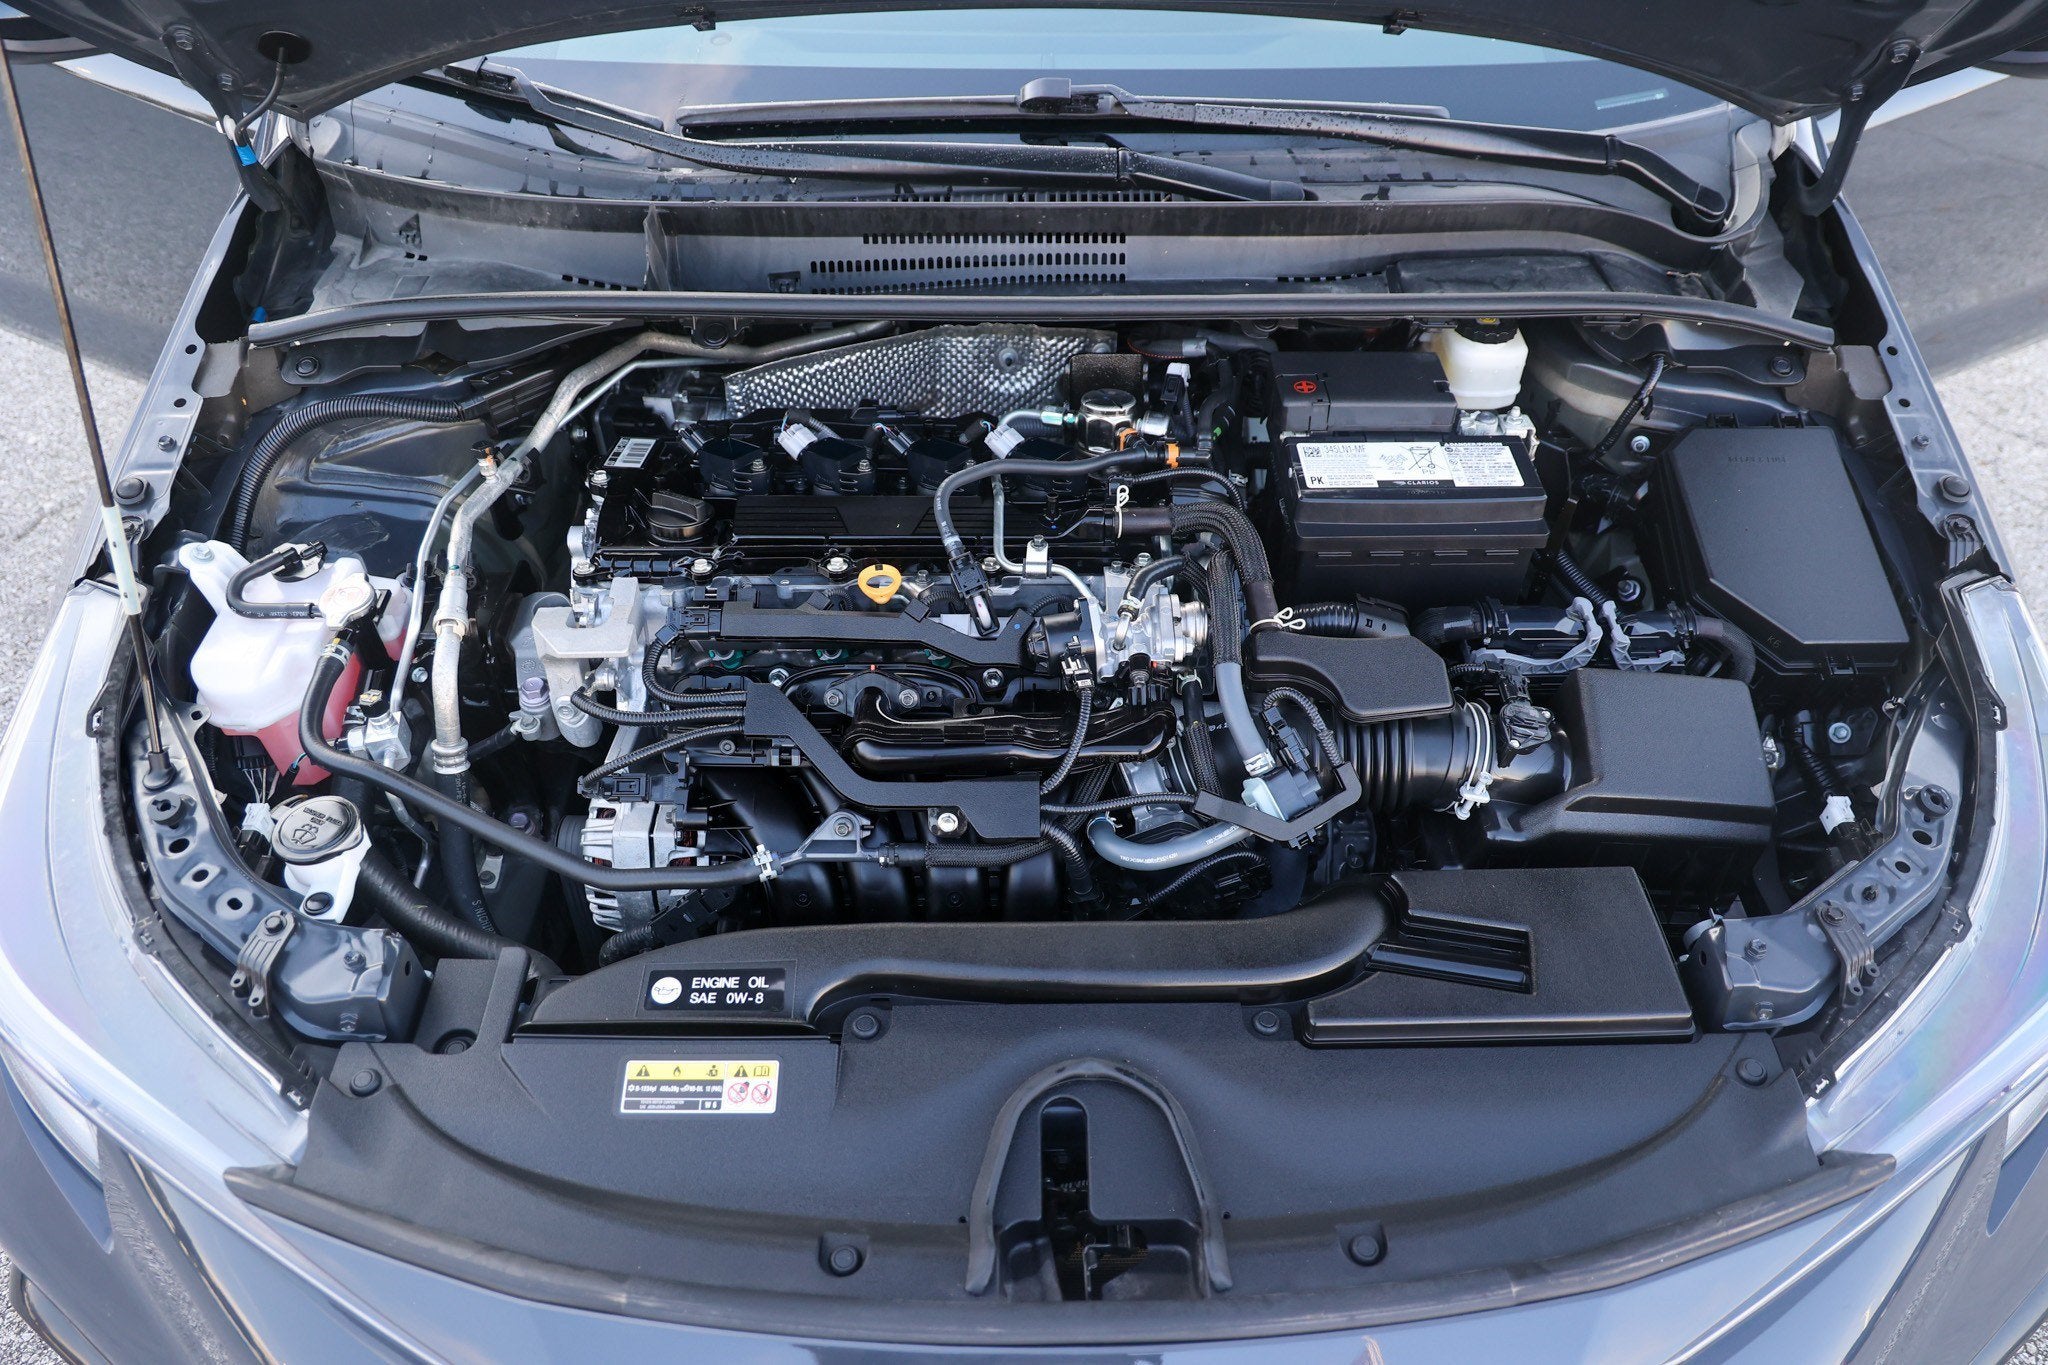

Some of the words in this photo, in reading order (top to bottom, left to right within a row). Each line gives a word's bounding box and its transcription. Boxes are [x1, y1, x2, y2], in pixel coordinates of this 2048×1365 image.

[1310, 476, 1325, 485] PK
[691, 976, 740, 989] ENGINE
[747, 976, 770, 989] OIL
[689, 991, 717, 1004] SAE
[725, 991, 765, 1004] 0W-8
